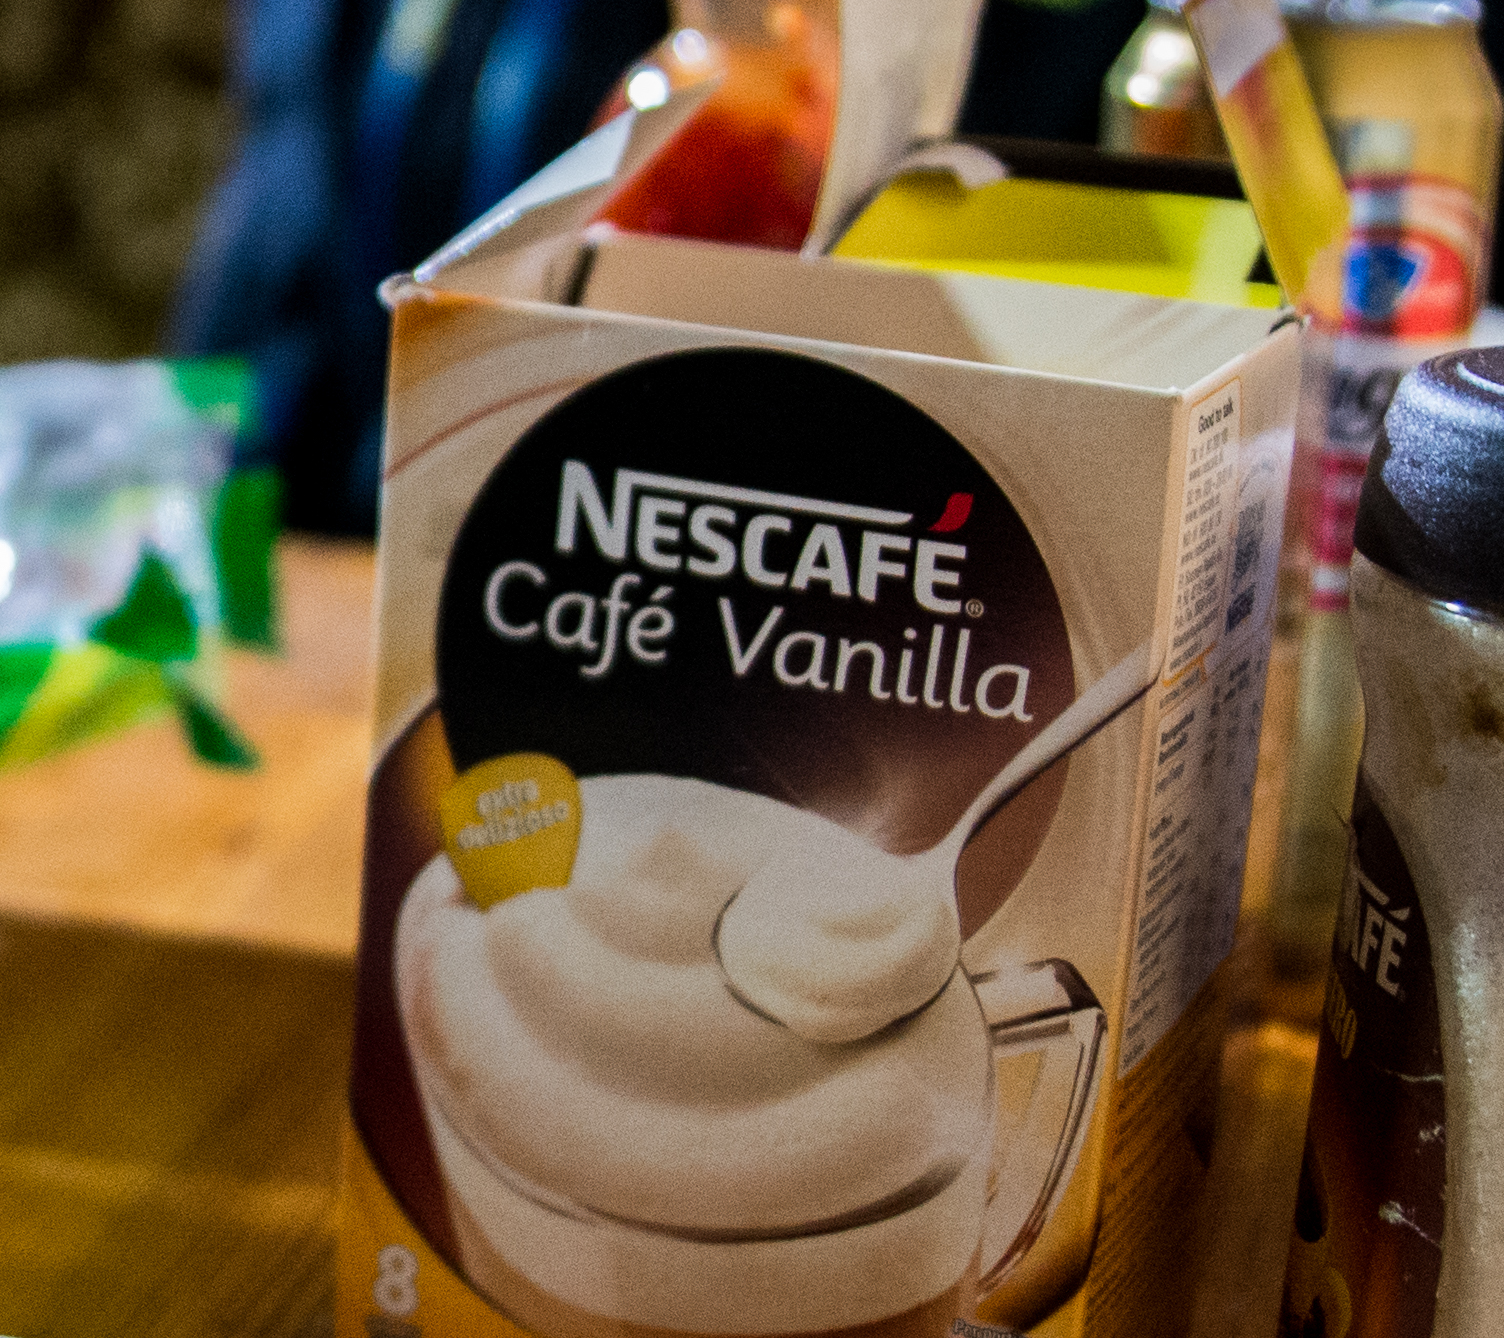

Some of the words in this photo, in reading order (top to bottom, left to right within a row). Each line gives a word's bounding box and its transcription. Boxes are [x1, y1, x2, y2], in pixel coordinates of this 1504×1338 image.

[553, 458, 974, 615] NESCAFÉ
[482, 560, 676, 678] Café
[717, 596, 1033, 723] Vanilla
[371, 1243, 421, 1317] 8
